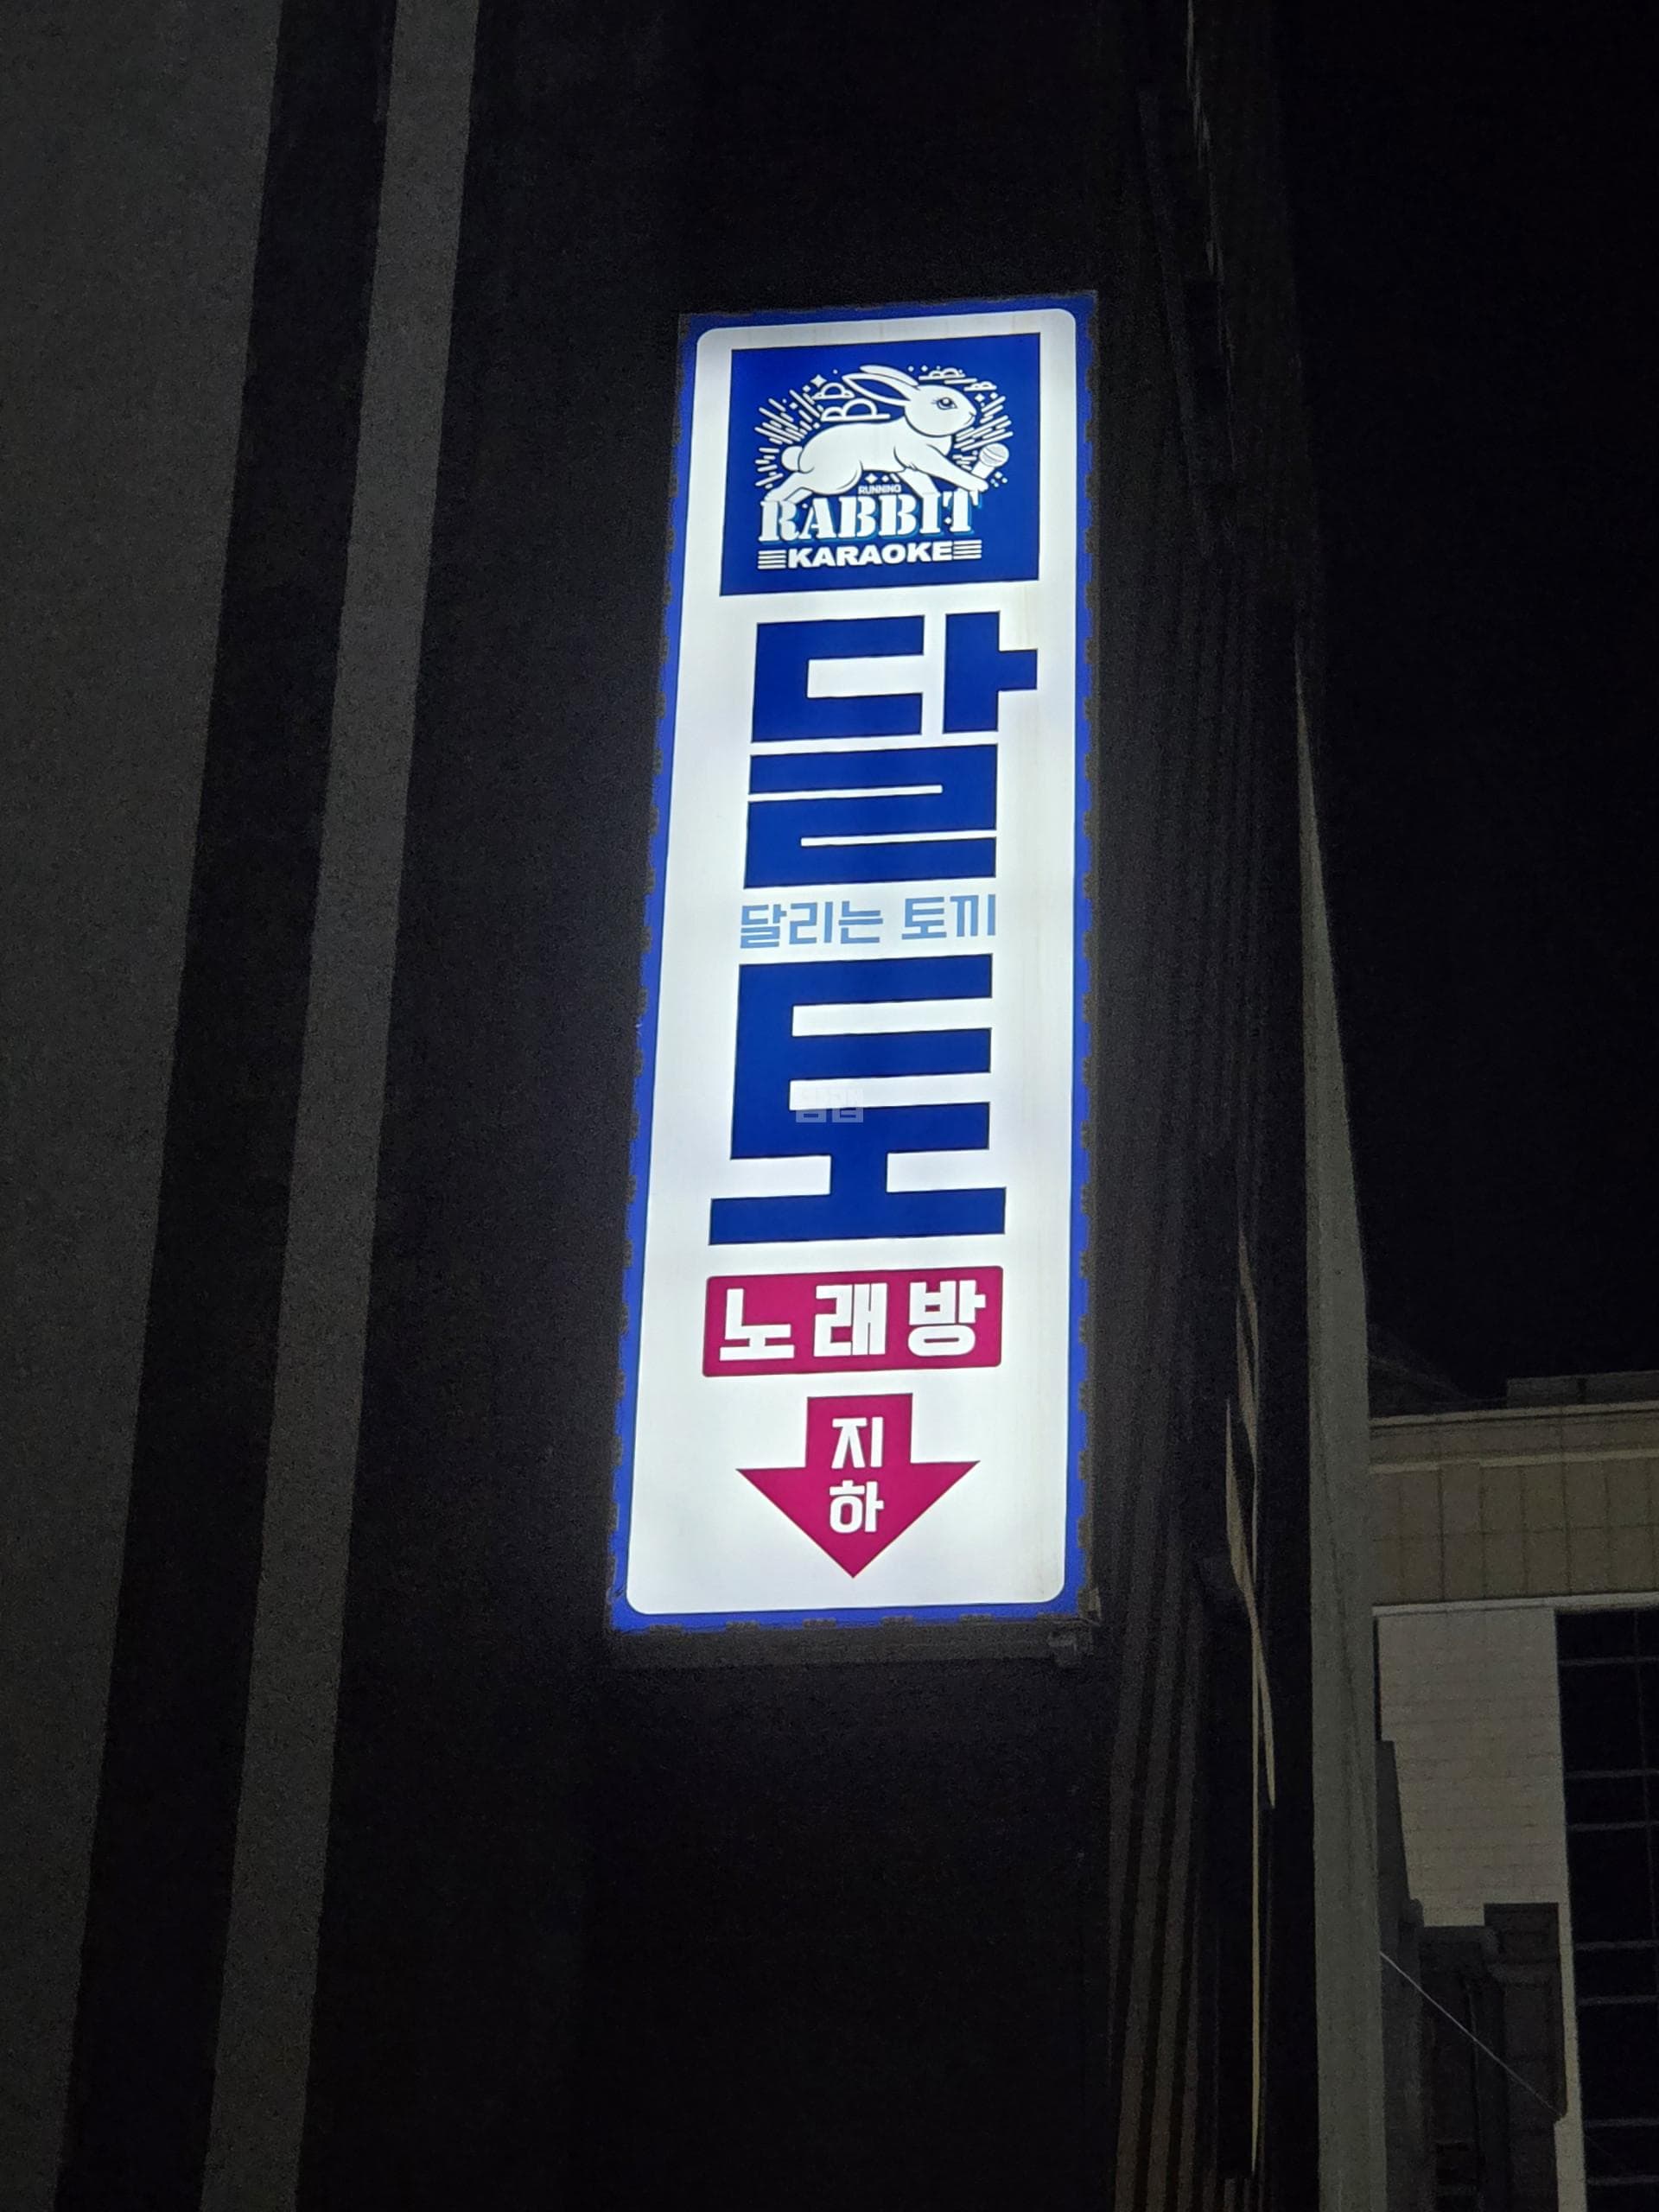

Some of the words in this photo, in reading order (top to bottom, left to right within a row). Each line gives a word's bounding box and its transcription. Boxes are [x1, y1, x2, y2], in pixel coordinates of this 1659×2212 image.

[759, 488, 981, 543] RABBIT
[858, 484, 901, 495] RUNNING
[788, 541, 952, 569] KARAOKE
[741, 900, 883, 949] 달리는
[901, 893, 996, 940] 토끼
[719, 1279, 987, 1362] 노래방
[829, 1416, 884, 1535] 지하
